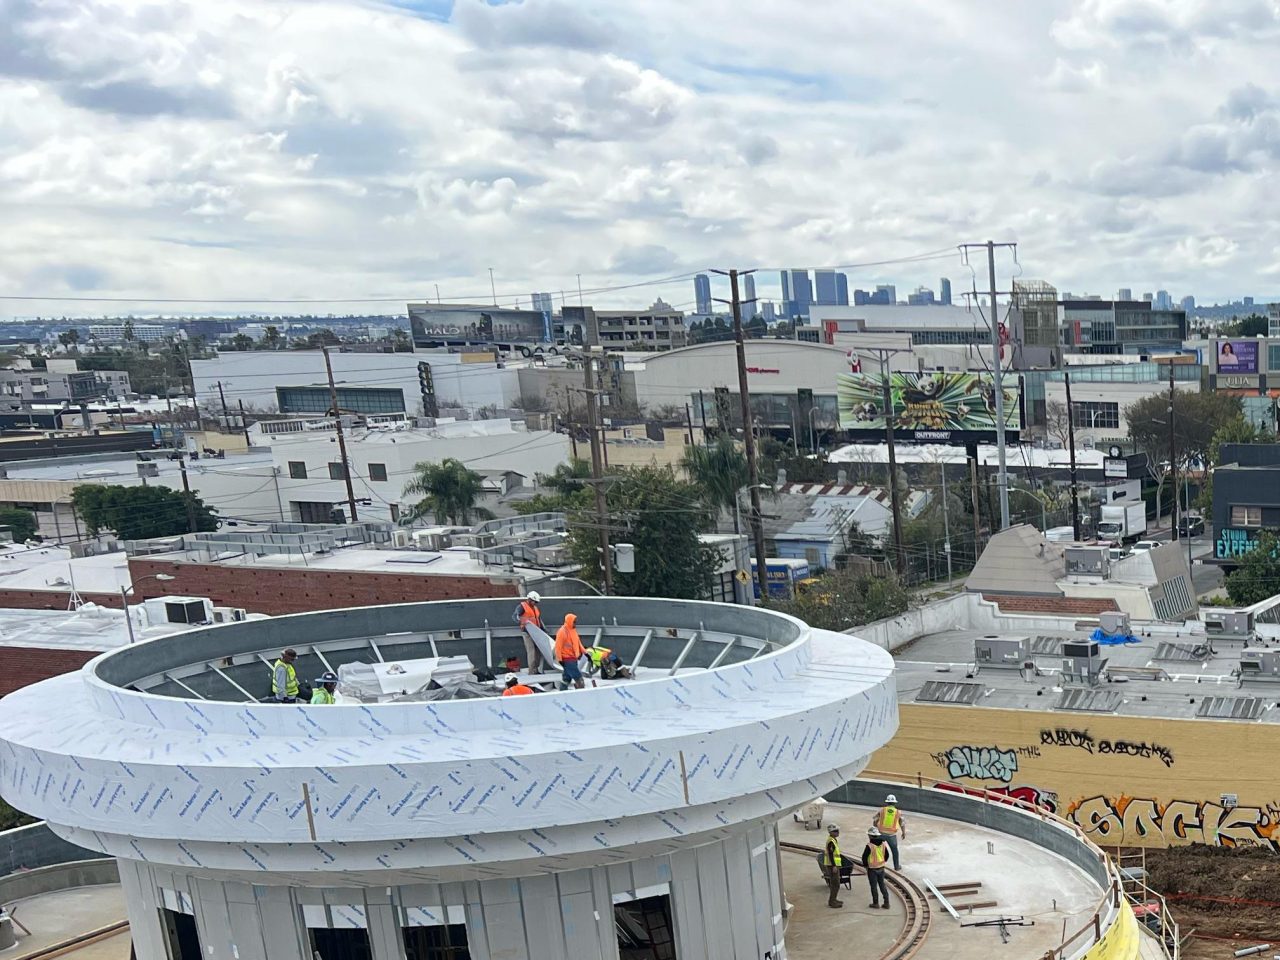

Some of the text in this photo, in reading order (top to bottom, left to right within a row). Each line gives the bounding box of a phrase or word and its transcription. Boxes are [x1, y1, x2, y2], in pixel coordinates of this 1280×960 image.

[424, 327, 460, 335] HALO
[915, 431, 951, 439] OUTFRONT
[1221, 528, 1247, 540] STUDIO
